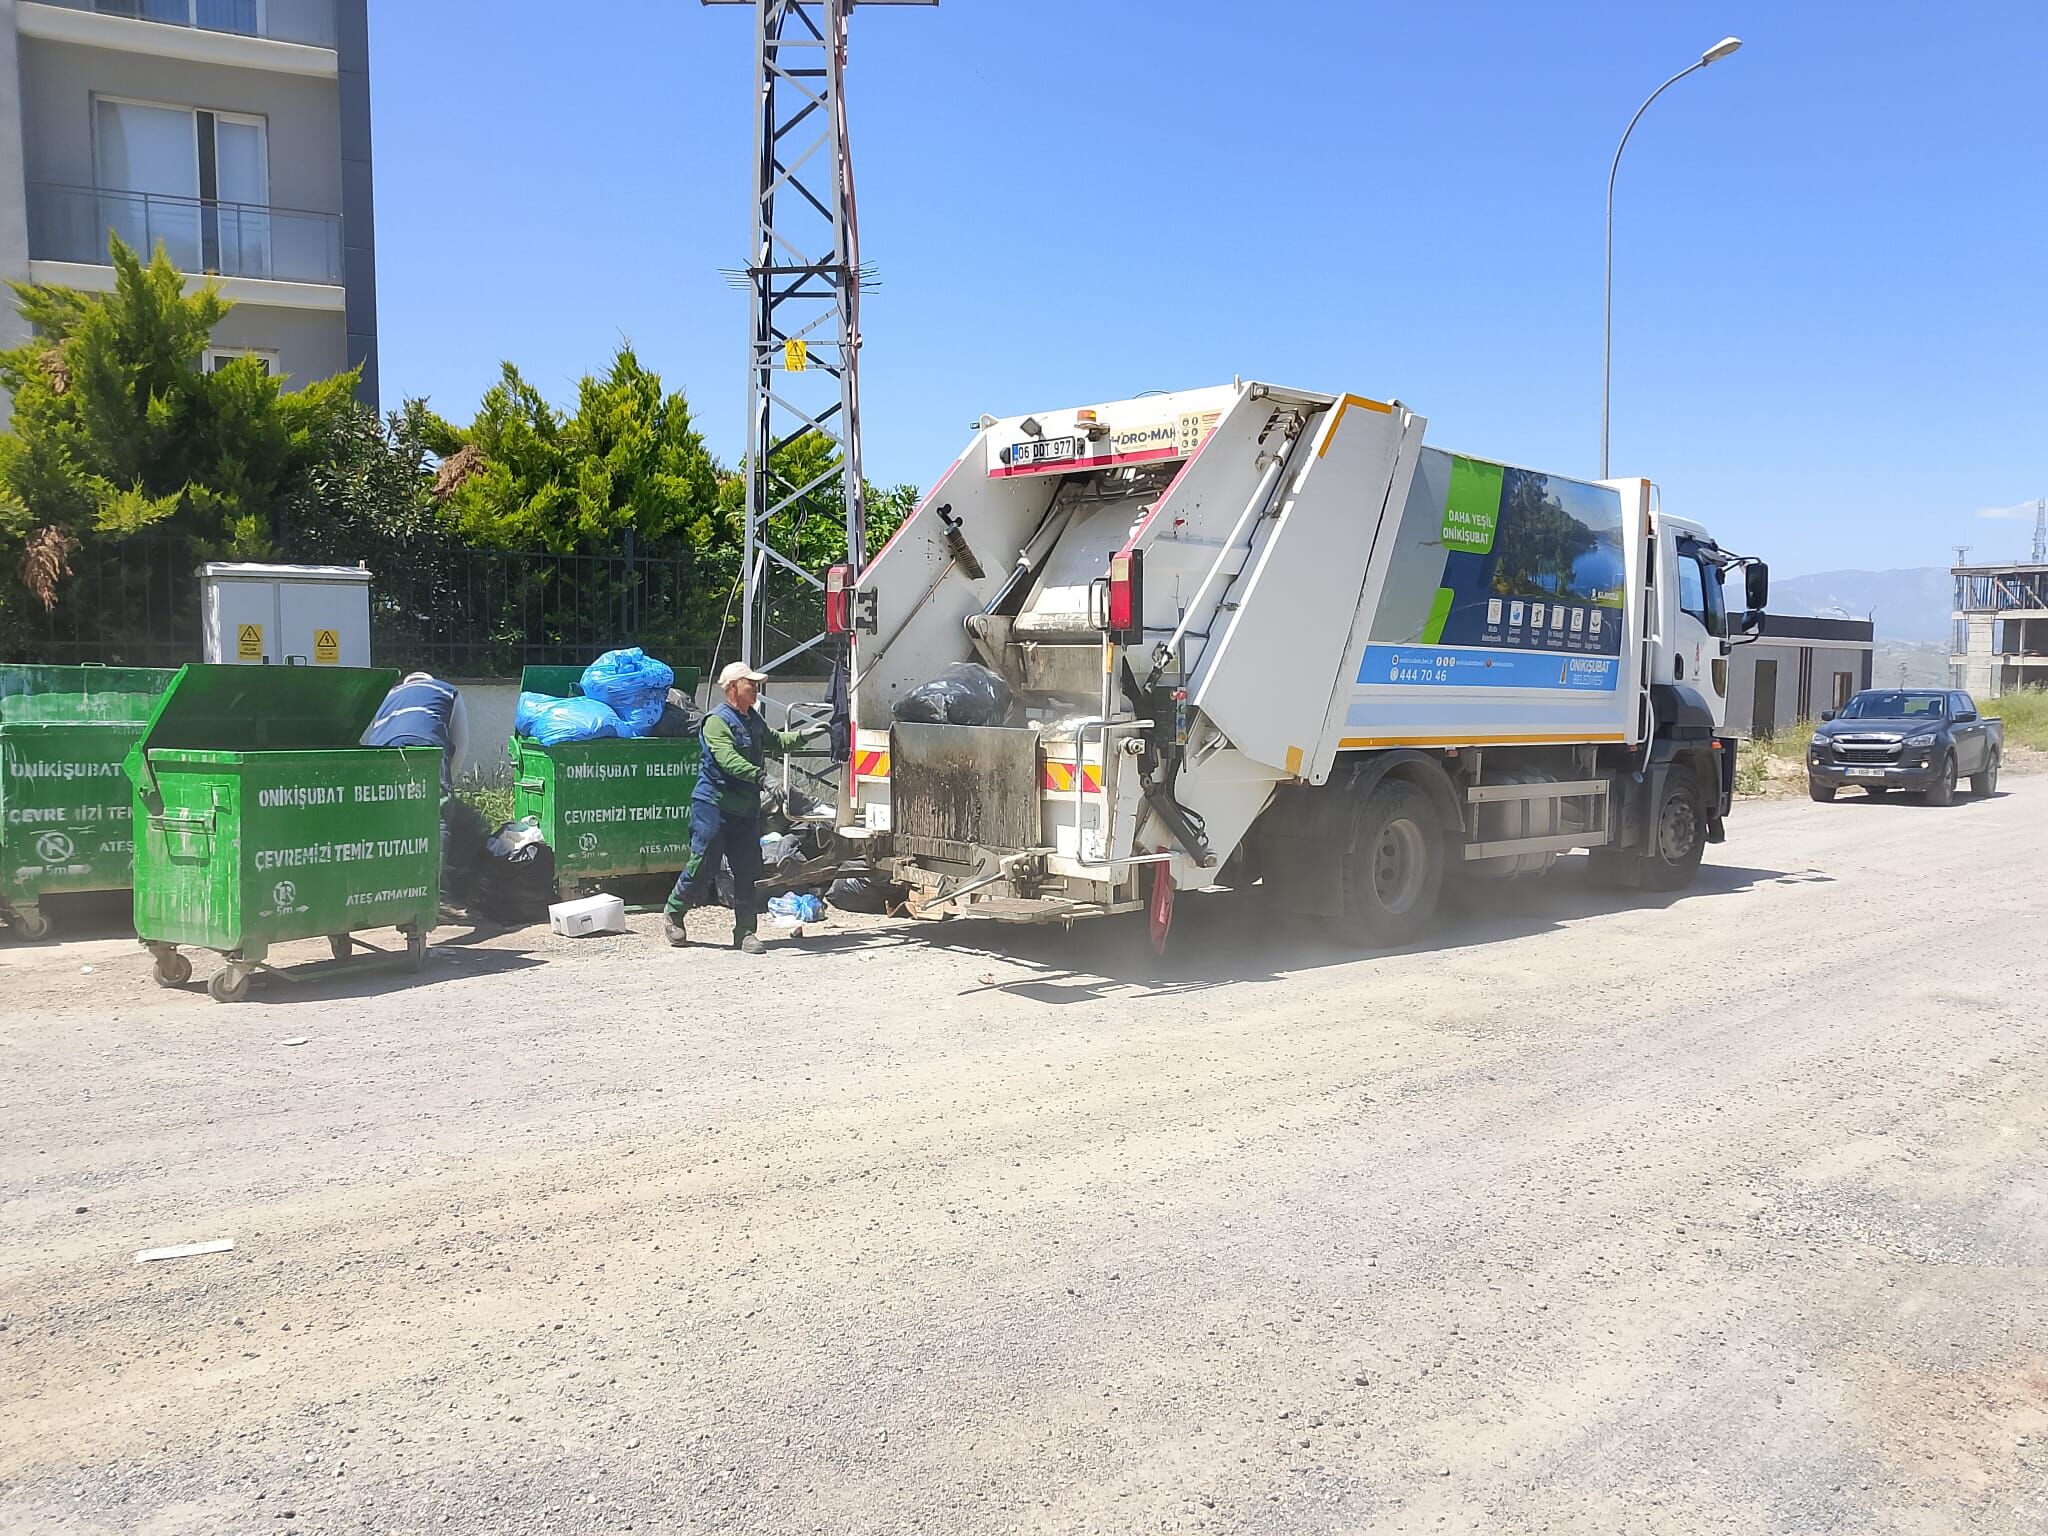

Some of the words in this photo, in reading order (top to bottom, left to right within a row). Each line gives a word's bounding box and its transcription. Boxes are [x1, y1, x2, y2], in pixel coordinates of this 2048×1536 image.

[1018, 446, 1030, 460] 06
[1033, 443, 1050, 457] DDT
[1054, 440, 1071, 455] 977
[1448, 509, 1471, 525] DAHA
[1471, 513, 1494, 530] YEŞİL
[1442, 525, 1489, 545] ONİKİŞUBAT
[1399, 668, 1418, 681] 444
[1420, 669, 1433, 681] 70
[1434, 669, 1447, 682] 46
[10, 760, 123, 780] ONİKİŞUBAT
[566, 762, 638, 781] ONİKİŞUBAT
[258, 784, 345, 809] ONİKİŞUBAT
[354, 779, 427, 802] BELEDİYESİ
[564, 805, 626, 826] ÇEVREMİZİ
[629, 804, 663, 821] TEMİZ
[255, 842, 332, 872] ÇEVREMİZİ
[334, 838, 375, 862] TEMİZ
[377, 837, 429, 858] TUTALIM
[46, 864, 67, 876] 5m
[346, 891, 373, 906] ATEŞ
[374, 886, 428, 902] ATMAYINIZ
[276, 905, 293, 916] 5m
